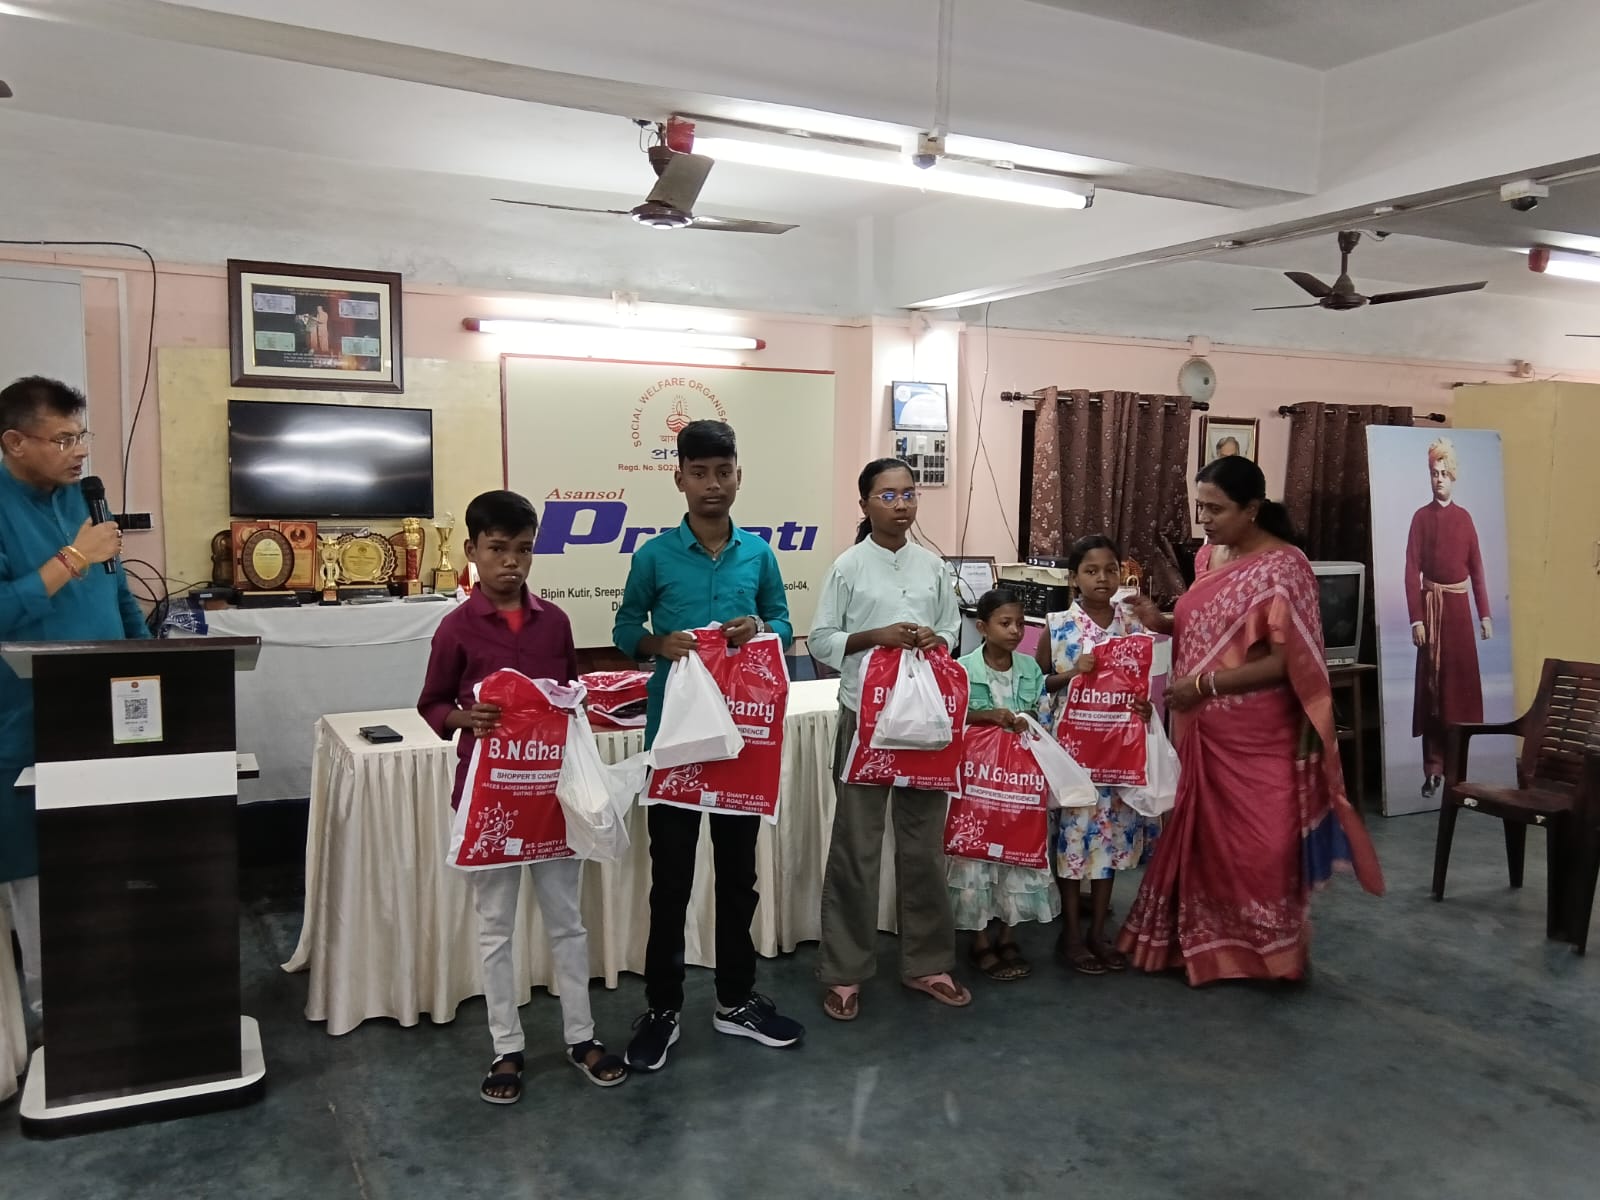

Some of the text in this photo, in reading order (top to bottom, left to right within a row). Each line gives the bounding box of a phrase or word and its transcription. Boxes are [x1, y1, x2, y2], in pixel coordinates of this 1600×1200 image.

[631, 377, 728, 447] SOCIAL WELFARE ORGANISA
[642, 464, 656, 472] No.
[545, 488, 625, 500] Asansol
[541, 581, 810, 600] Bipin Kutir, Sreepa sol-04,
[496, 771, 537, 780] SHOPPER'S
[726, 791, 749, 800] GHANTY
